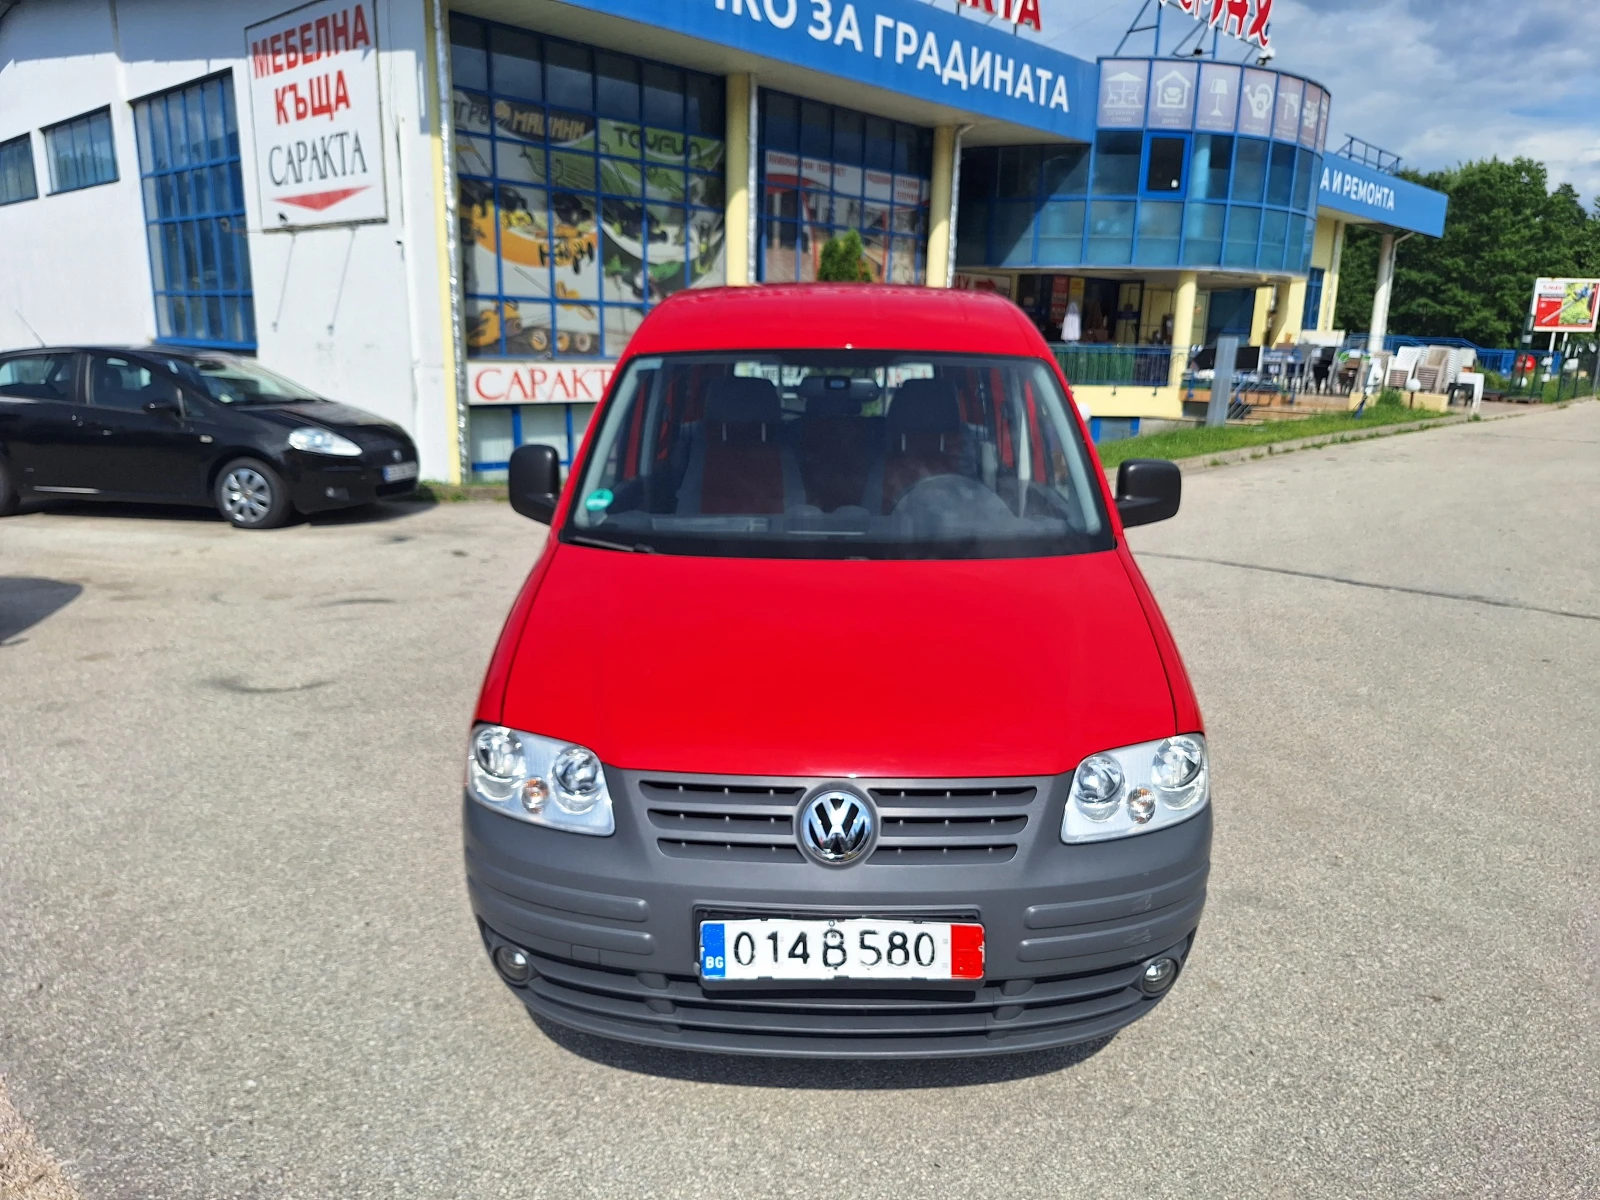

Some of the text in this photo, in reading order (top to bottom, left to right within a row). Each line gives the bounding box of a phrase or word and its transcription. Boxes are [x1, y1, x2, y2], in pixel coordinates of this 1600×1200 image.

[252, 3, 370, 79] МЕБЕЛНА
[807, 0, 863, 53] ЗА
[873, 14, 1070, 113] ГРАДИНАТА
[274, 69, 351, 126] КЪЩА
[268, 129, 369, 187] САРАКТА
[1332, 168, 1343, 195] И
[1342, 173, 1395, 212] РЕМОНТА
[475, 368, 613, 401] САРАКТ
[705, 955, 725, 969] BG
